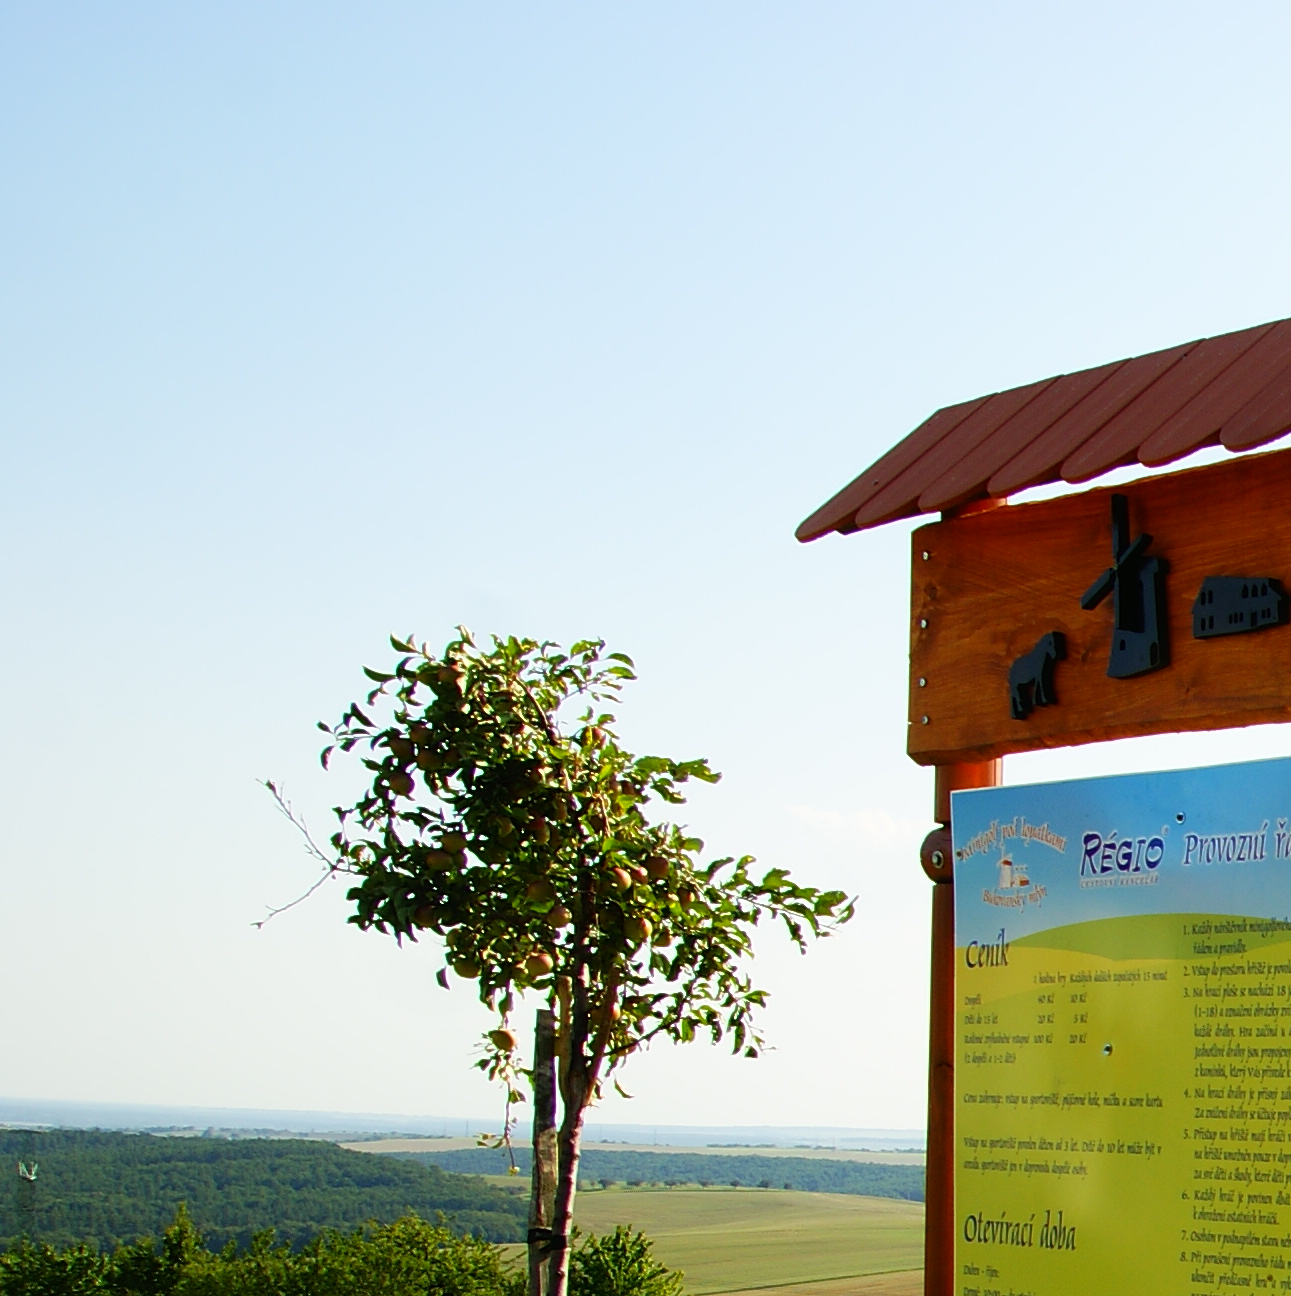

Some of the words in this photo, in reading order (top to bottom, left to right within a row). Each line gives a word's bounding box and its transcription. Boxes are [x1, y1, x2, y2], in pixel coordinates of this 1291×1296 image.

[1081, 831, 1165, 876] RÉGIO
[1184, 820, 1269, 865] Provozní
[965, 928, 1010, 969] Ceník
[964, 1211, 1036, 1248] Otevírací
[1040, 1210, 1077, 1250] doba
